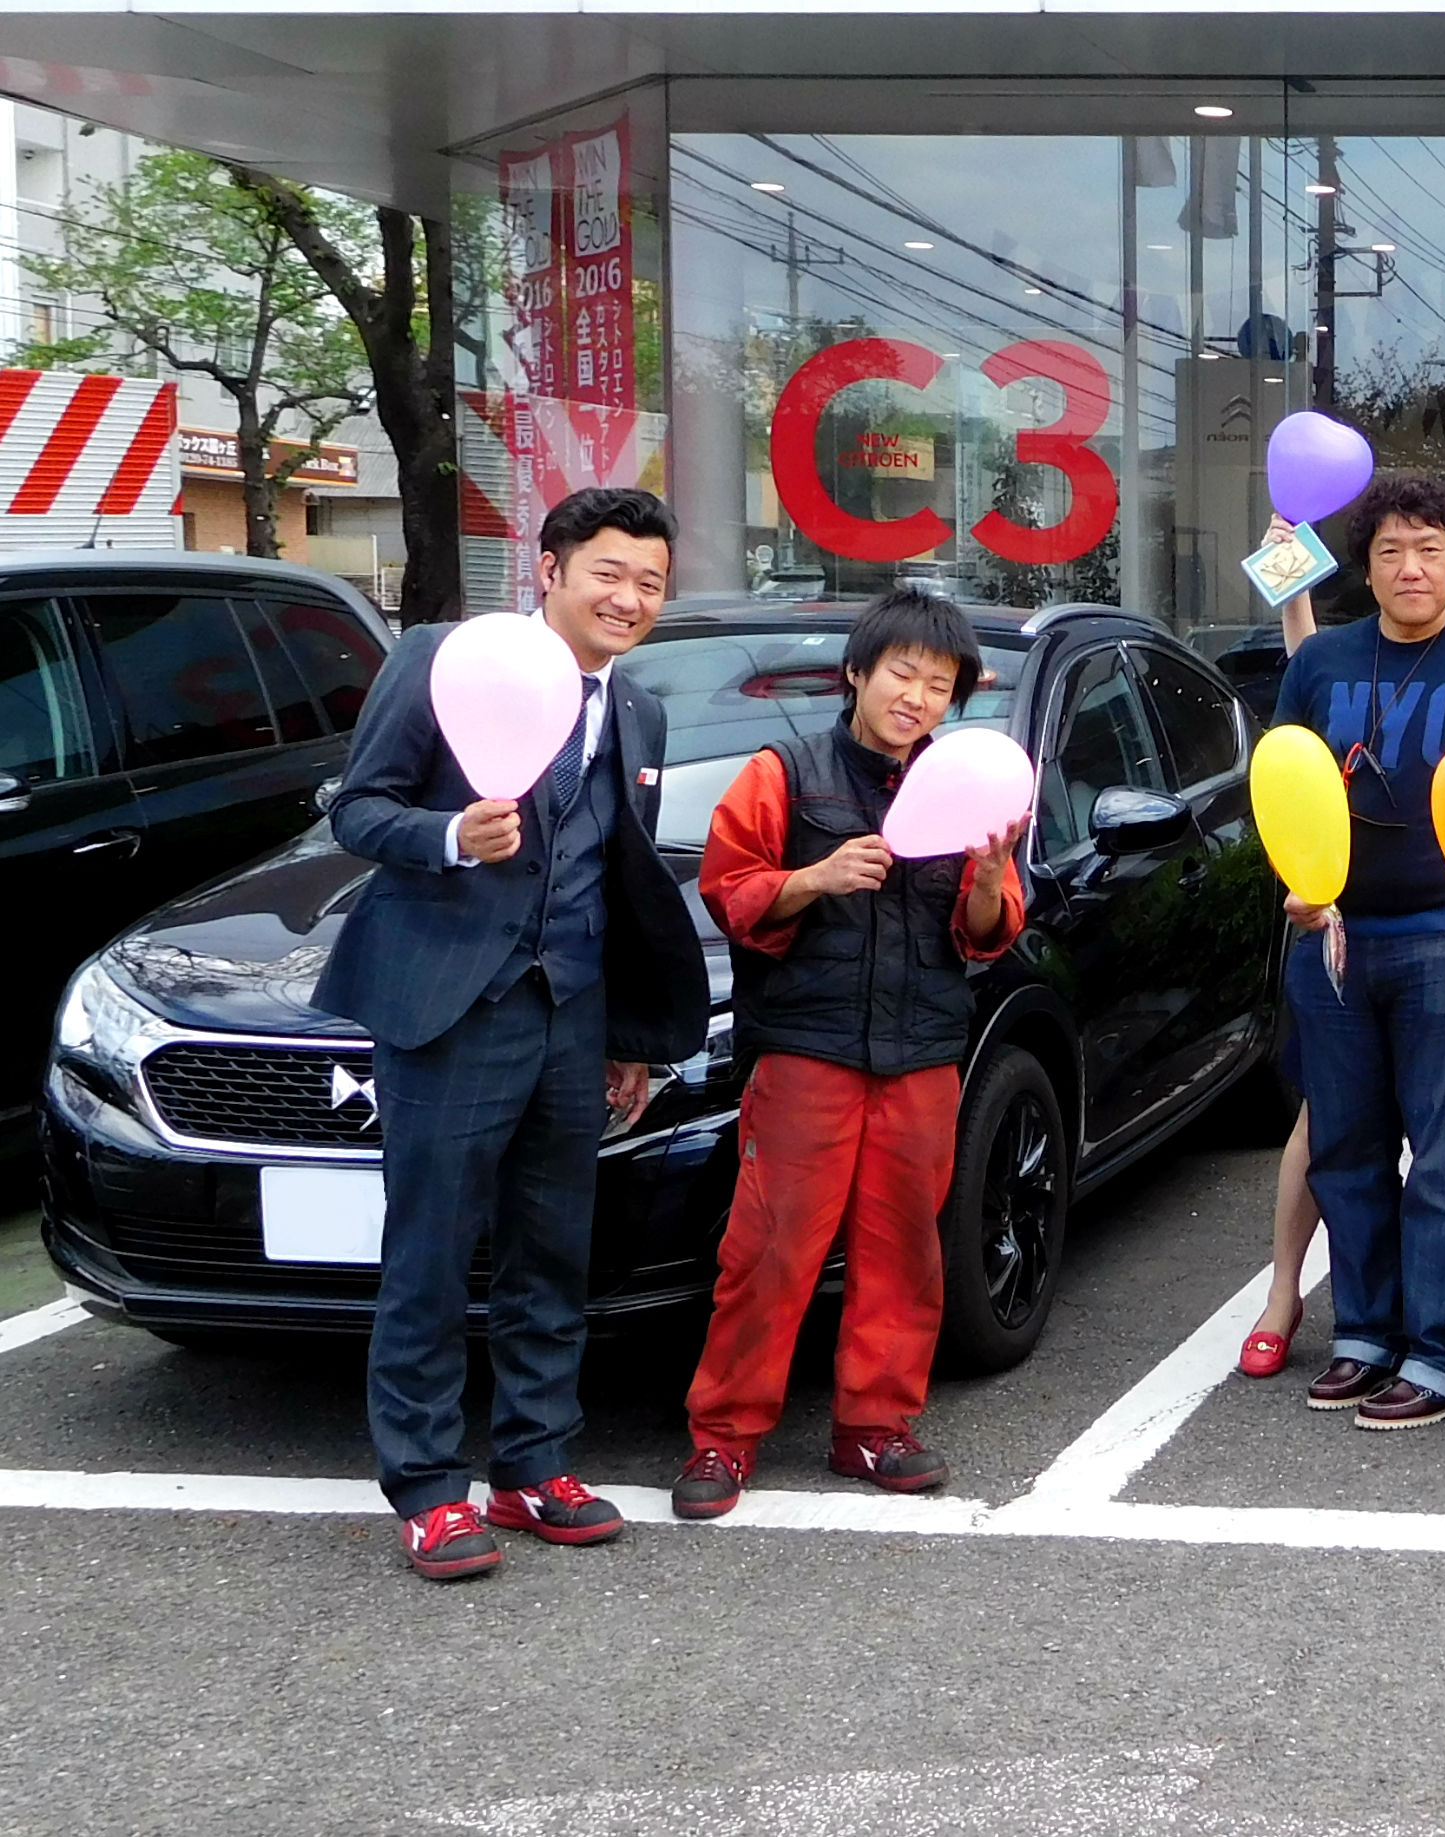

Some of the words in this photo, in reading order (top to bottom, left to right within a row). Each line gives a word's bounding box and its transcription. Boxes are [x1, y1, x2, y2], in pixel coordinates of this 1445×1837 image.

[577, 179, 604, 217] THE
[577, 212, 618, 252] GOLD
[575, 256, 622, 299] 2016
[770, 338, 1117, 564] C3
[856, 433, 899, 447] NEW
